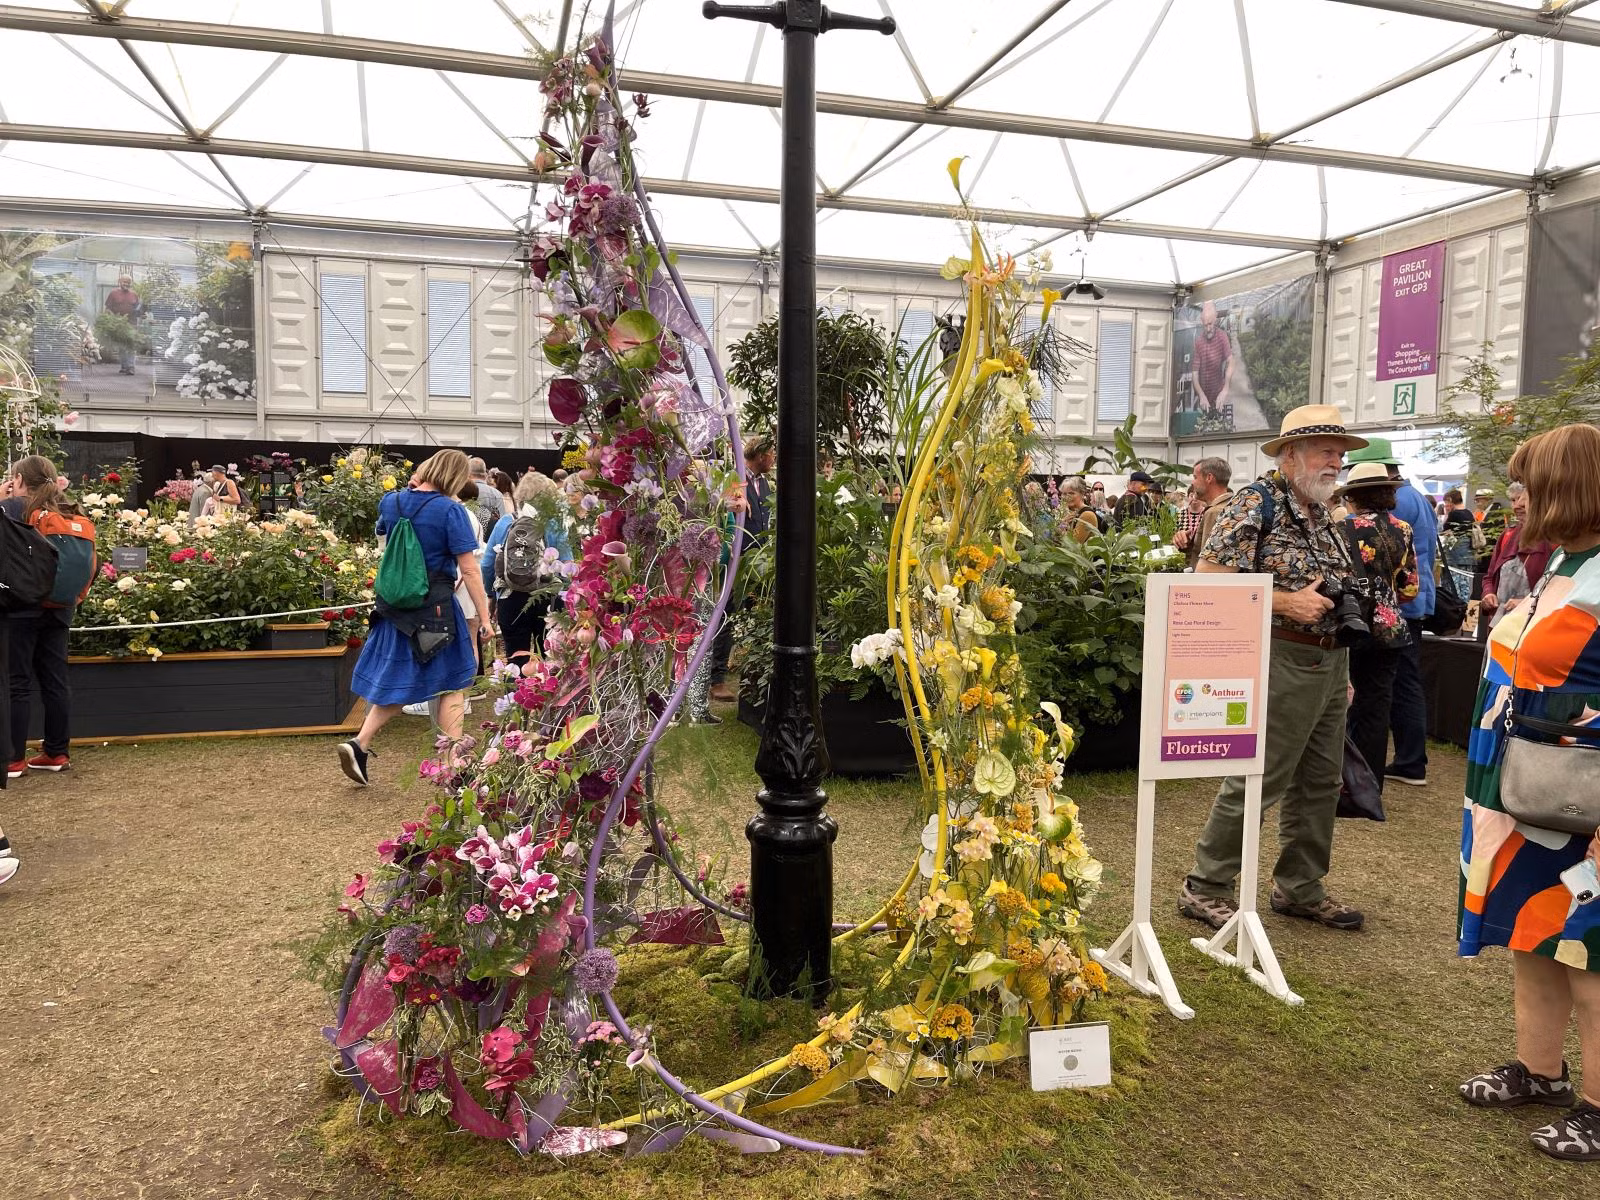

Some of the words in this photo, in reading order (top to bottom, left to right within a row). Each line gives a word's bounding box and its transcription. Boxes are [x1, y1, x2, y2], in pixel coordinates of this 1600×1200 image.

[1400, 259, 1427, 274] GREAT
[1393, 269, 1432, 286] PAVILION
[1395, 288, 1410, 298] EXIT
[1412, 282, 1428, 294] GP3
[1395, 349, 1420, 358] Shopping
[1395, 364, 1421, 374] Courtyard
[1166, 740, 1231, 757] Floristry
